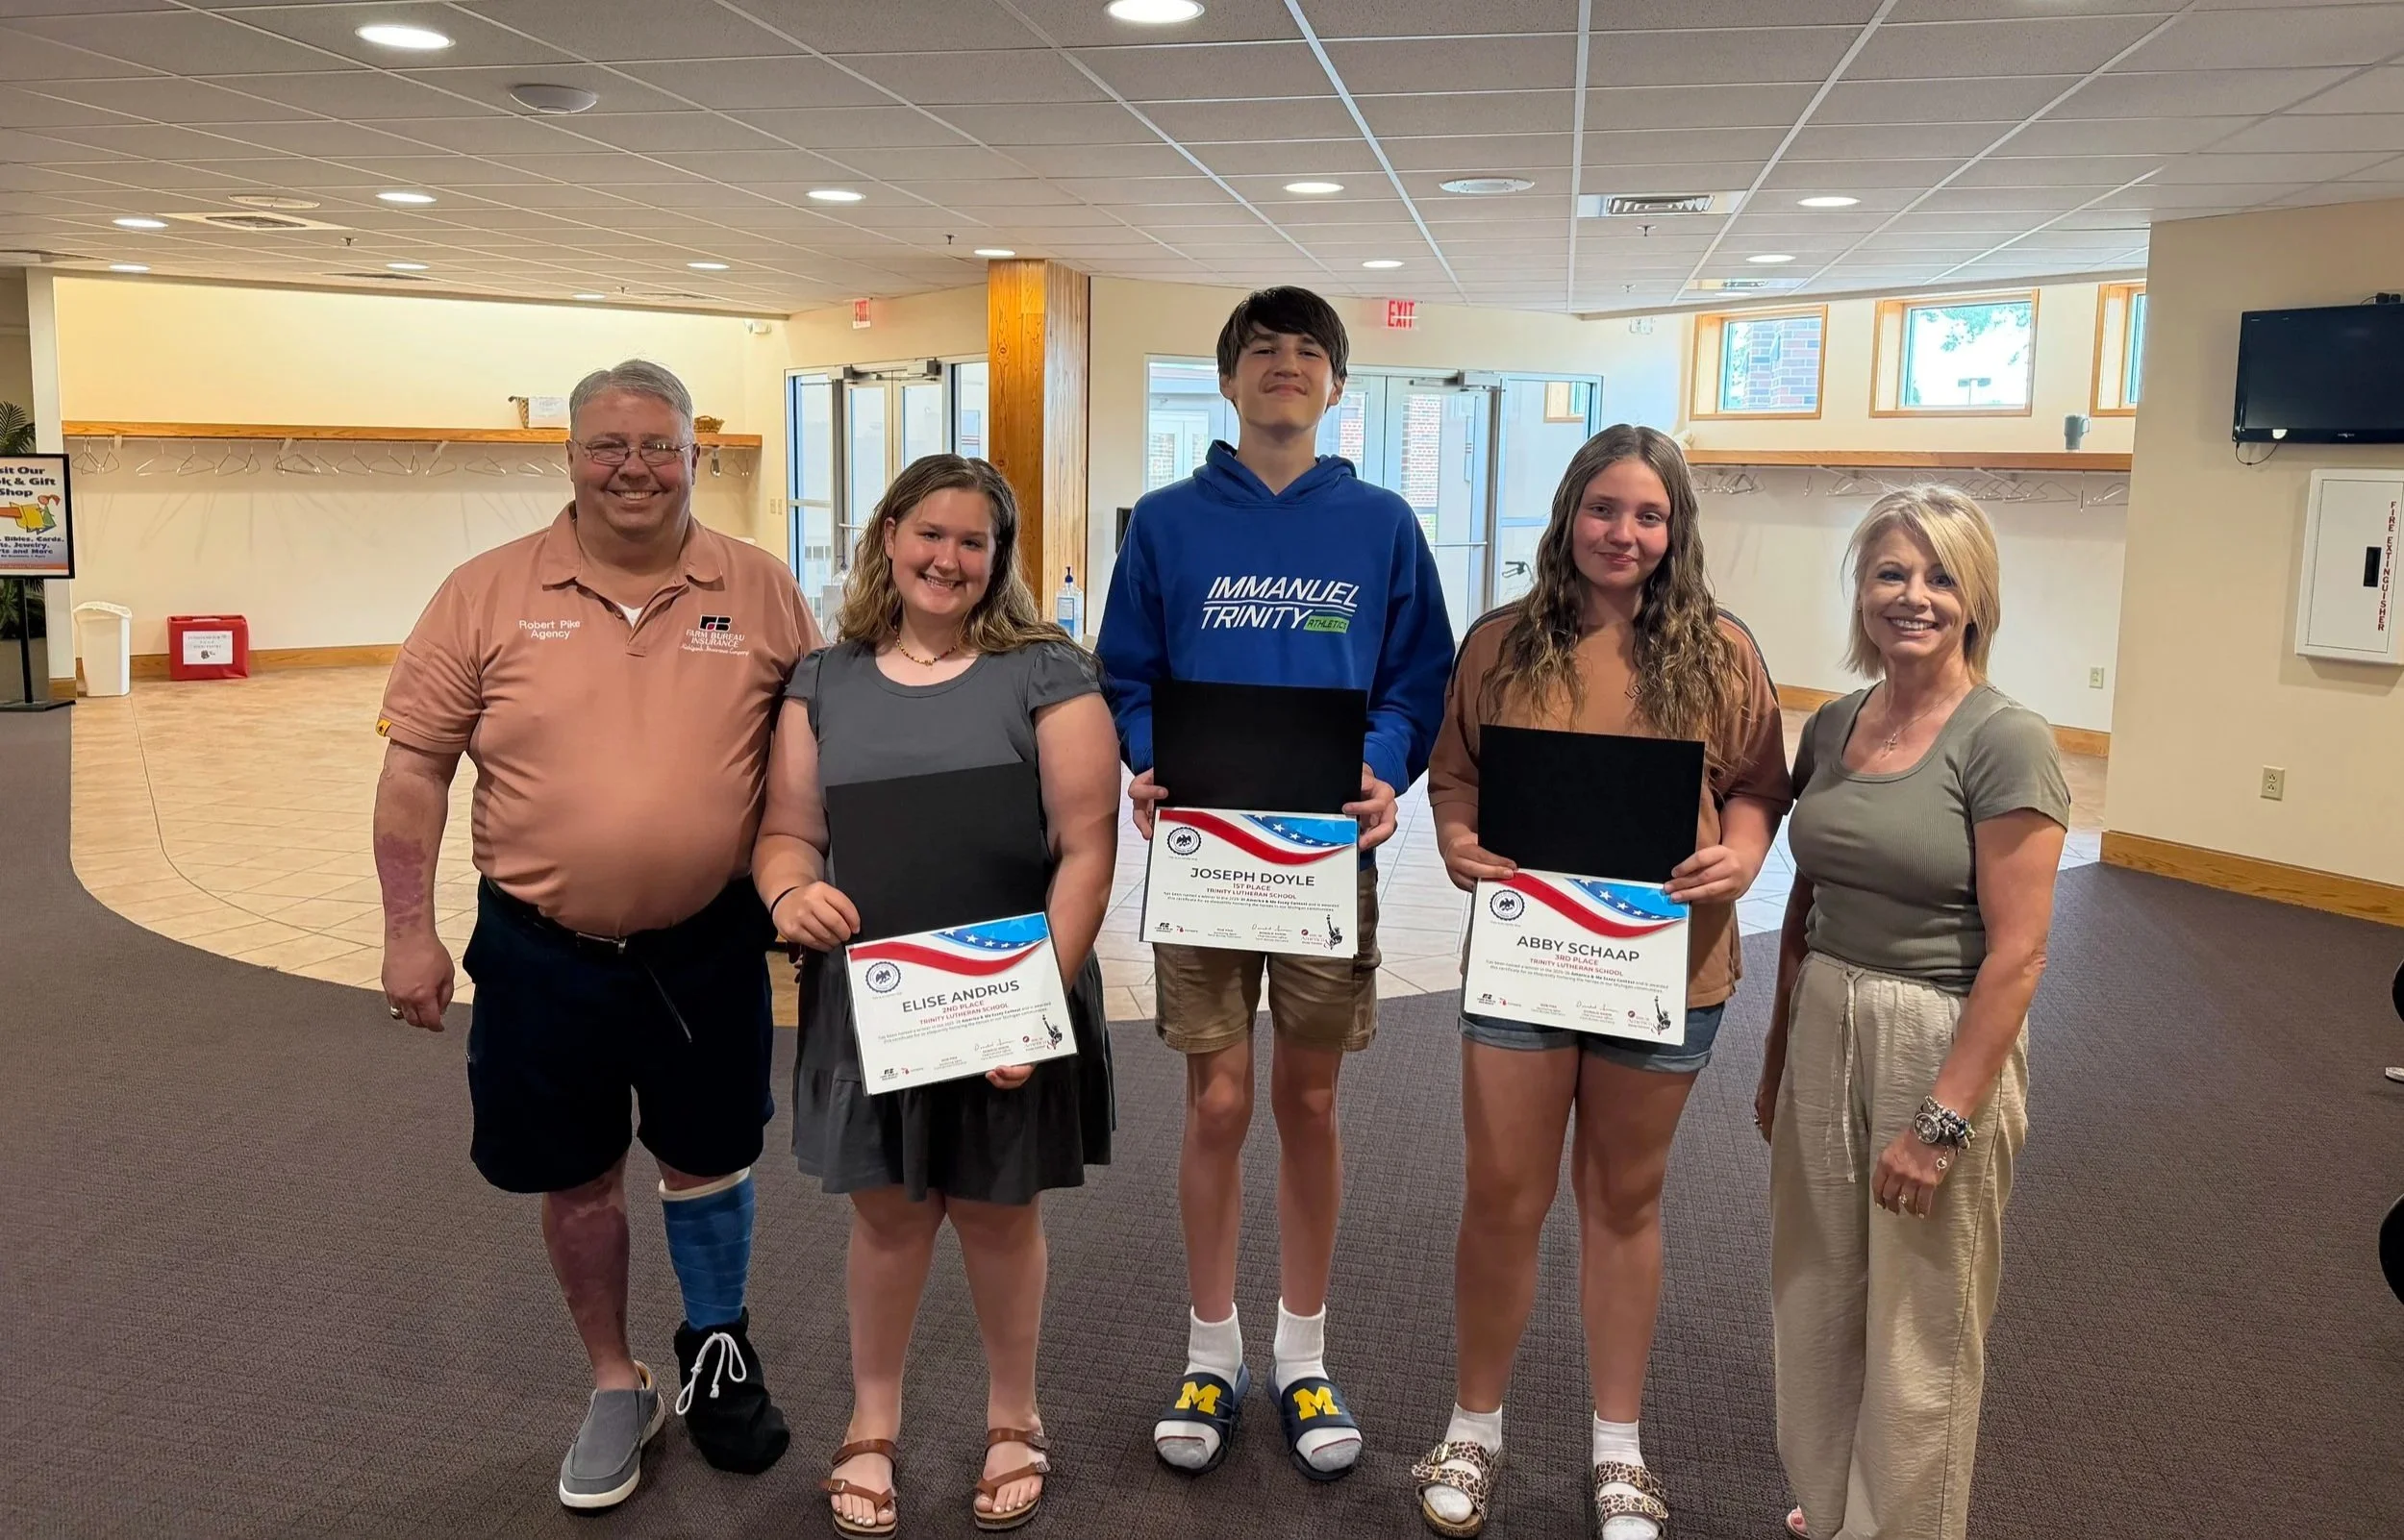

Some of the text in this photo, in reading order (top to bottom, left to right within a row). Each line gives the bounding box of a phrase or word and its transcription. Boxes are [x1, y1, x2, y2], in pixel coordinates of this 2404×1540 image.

[1388, 300, 1415, 328] EXIT
[17, 466, 45, 475] Our
[0, 488, 33, 498] Shop
[2388, 501, 2396, 532] FIRE
[1207, 575, 1360, 608] IMMANUEL
[2378, 536, 2392, 631] EXTINGUISHER
[519, 620, 581, 630] Robert Pike
[1201, 606, 1314, 630] TRINITY
[530, 630, 570, 640] Agency
[686, 629, 745, 641] FARM BUREAU
[691, 637, 739, 648] INSURANCE
[1190, 867, 1315, 886] JOSEPH DOYLE
[1516, 935, 1640, 962] ABBY SCHAAP
[1557, 962, 1593, 972] LUTHERAN
[1594, 967, 1623, 977] SCHOOL
[1572, 956, 1599, 966] PLACE
[902, 980, 1020, 1012] ELISE ANDRUS
[919, 1015, 945, 1025] TRINITY
[946, 1008, 981, 1020] LUTHERAN
[982, 1003, 1008, 1012] SCHOOL
[942, 1000, 985, 1013] 2ND PLACE
[1175, 1381, 1221, 1415] M
[1293, 1386, 1340, 1420] M
